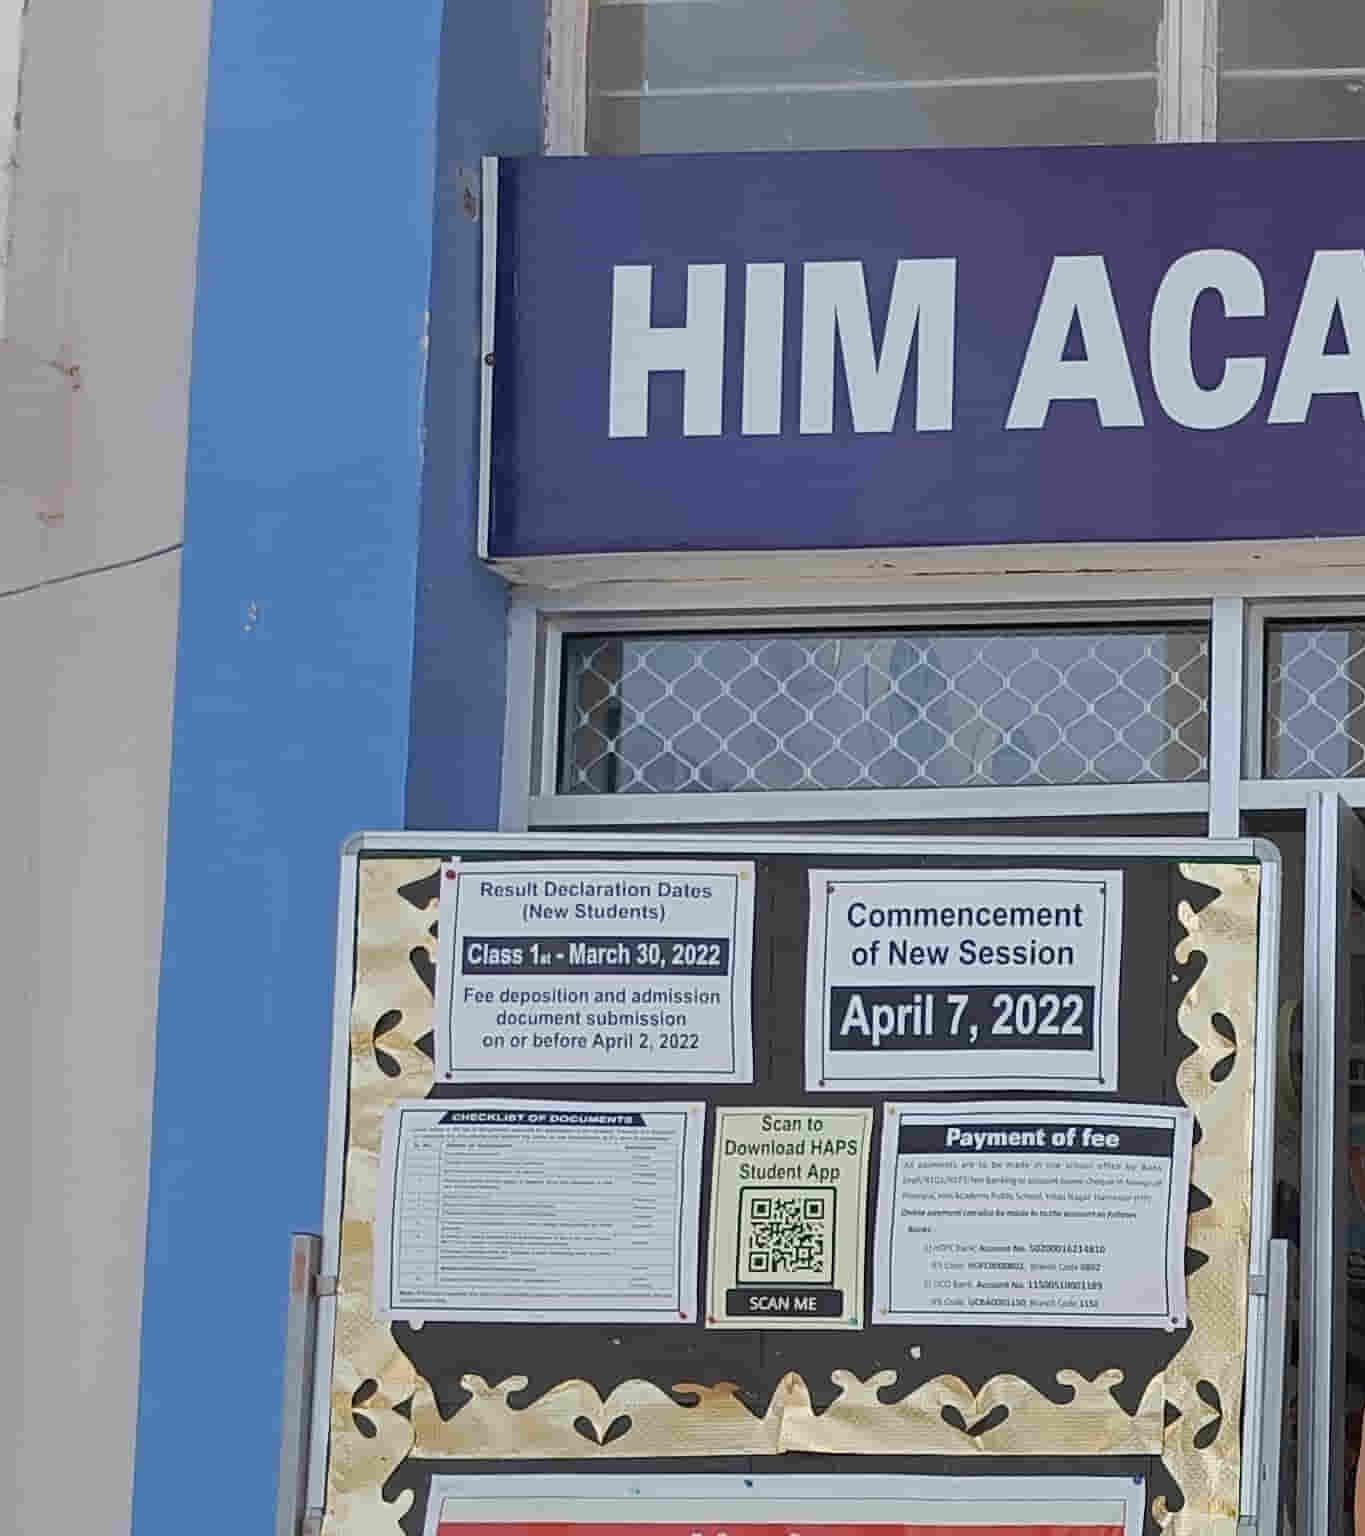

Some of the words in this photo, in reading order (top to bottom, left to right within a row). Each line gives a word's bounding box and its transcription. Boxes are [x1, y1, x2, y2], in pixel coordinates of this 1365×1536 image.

[609, 258, 956, 437] HIM
[481, 882, 538, 896] Result
[545, 880, 650, 896] Declaration
[658, 882, 712, 898] Dates
[523, 904, 568, 921] (New
[576, 904, 665, 923] Students)
[848, 903, 1083, 928] Commencement
[468, 944, 522, 964] Class
[568, 943, 630, 964] March
[637, 944, 665, 968] 30,
[672, 944, 720, 965] 2022
[852, 940, 880, 965] of
[889, 940, 949, 965] New
[960, 940, 1073, 965] Session
[464, 987, 493, 1003] Fee
[500, 988, 588, 1006] deposition
[594, 989, 625, 1003] and
[632, 988, 720, 1004] admission
[497, 1010, 580, 1025] document
[587, 1011, 686, 1026] submission
[840, 994, 933, 1046] April
[948, 995, 977, 1042] 7,
[992, 994, 1083, 1034] 2022
[483, 1036, 504, 1048] on
[510, 1036, 528, 1048] or
[533, 1032, 587, 1048] before
[592, 1033, 632, 1052] April
[640, 1033, 653, 1049] 2,
[660, 1033, 698, 1048] 2022
[451, 1113, 523, 1121] CHECKLIST
[528, 1114, 545, 1122] OF
[551, 1114, 633, 1124] DOCUMENTS
[762, 1114, 801, 1131] Scan
[808, 1118, 823, 1132] to
[725, 1139, 805, 1155] Download
[811, 1140, 857, 1155] HAPS
[946, 1128, 1045, 1150] Payment
[1052, 1128, 1076, 1146] of
[1082, 1128, 1119, 1147] fee
[739, 1163, 801, 1180] Student
[808, 1164, 840, 1184] App
[750, 1296, 789, 1310] SCAN
[794, 1297, 816, 1310] ME
